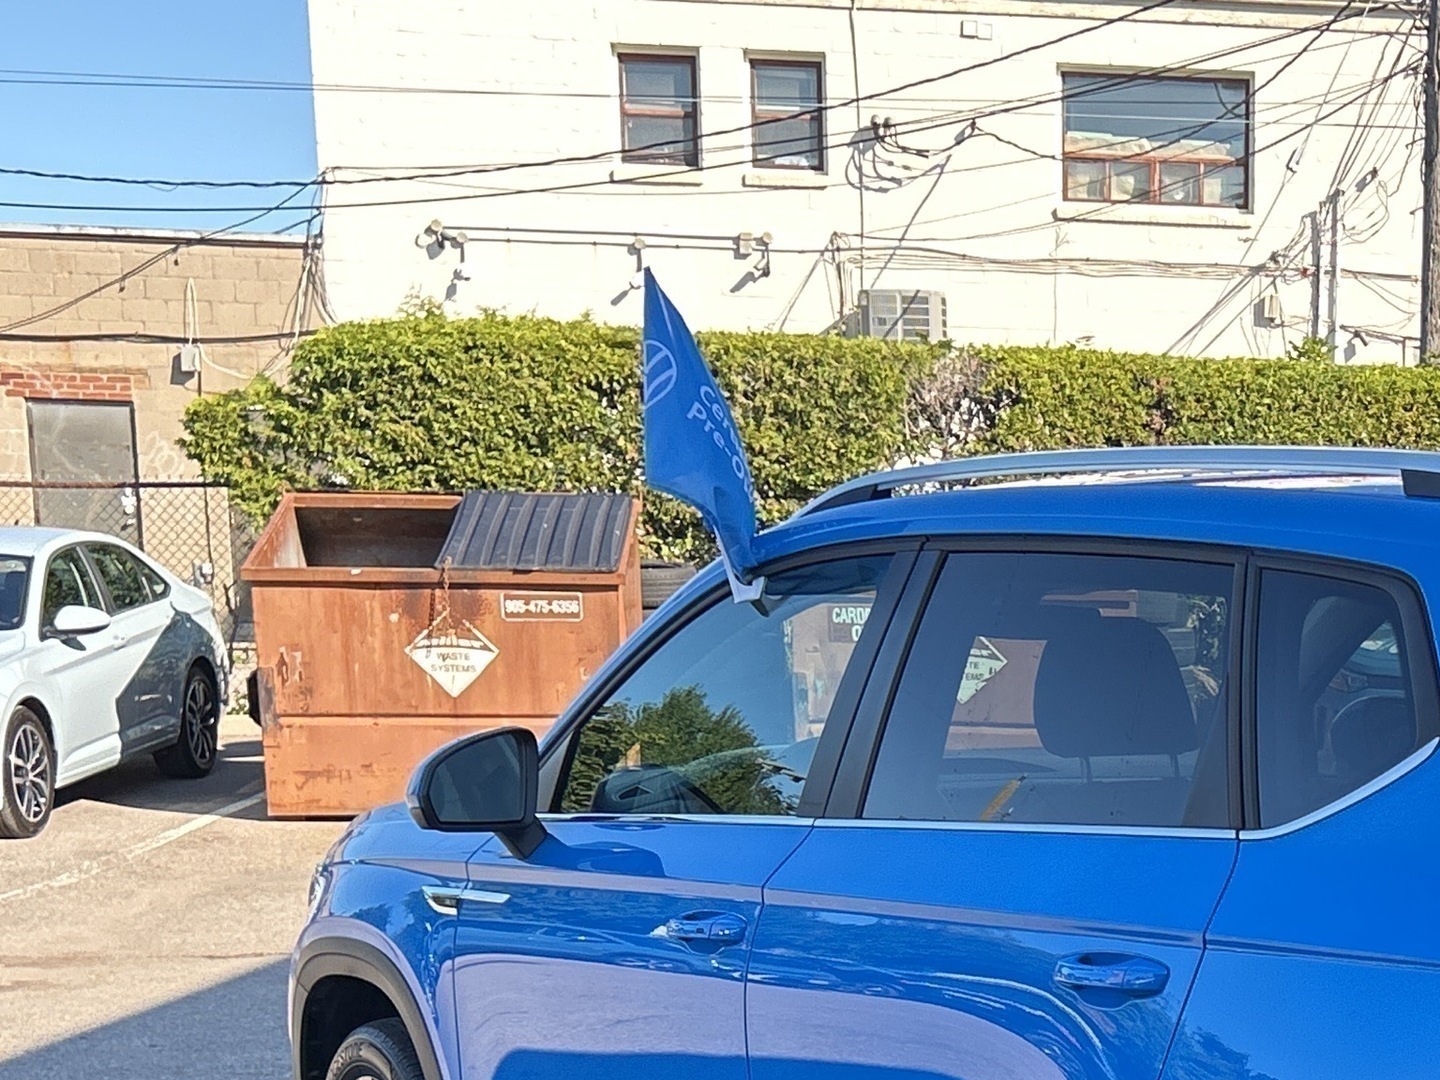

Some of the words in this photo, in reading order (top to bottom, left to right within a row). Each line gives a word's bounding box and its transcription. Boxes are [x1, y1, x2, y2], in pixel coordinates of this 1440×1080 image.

[851, 624, 864, 642] O
[436, 651, 471, 662] WASTE
[430, 664, 477, 673] SYSTEMS
